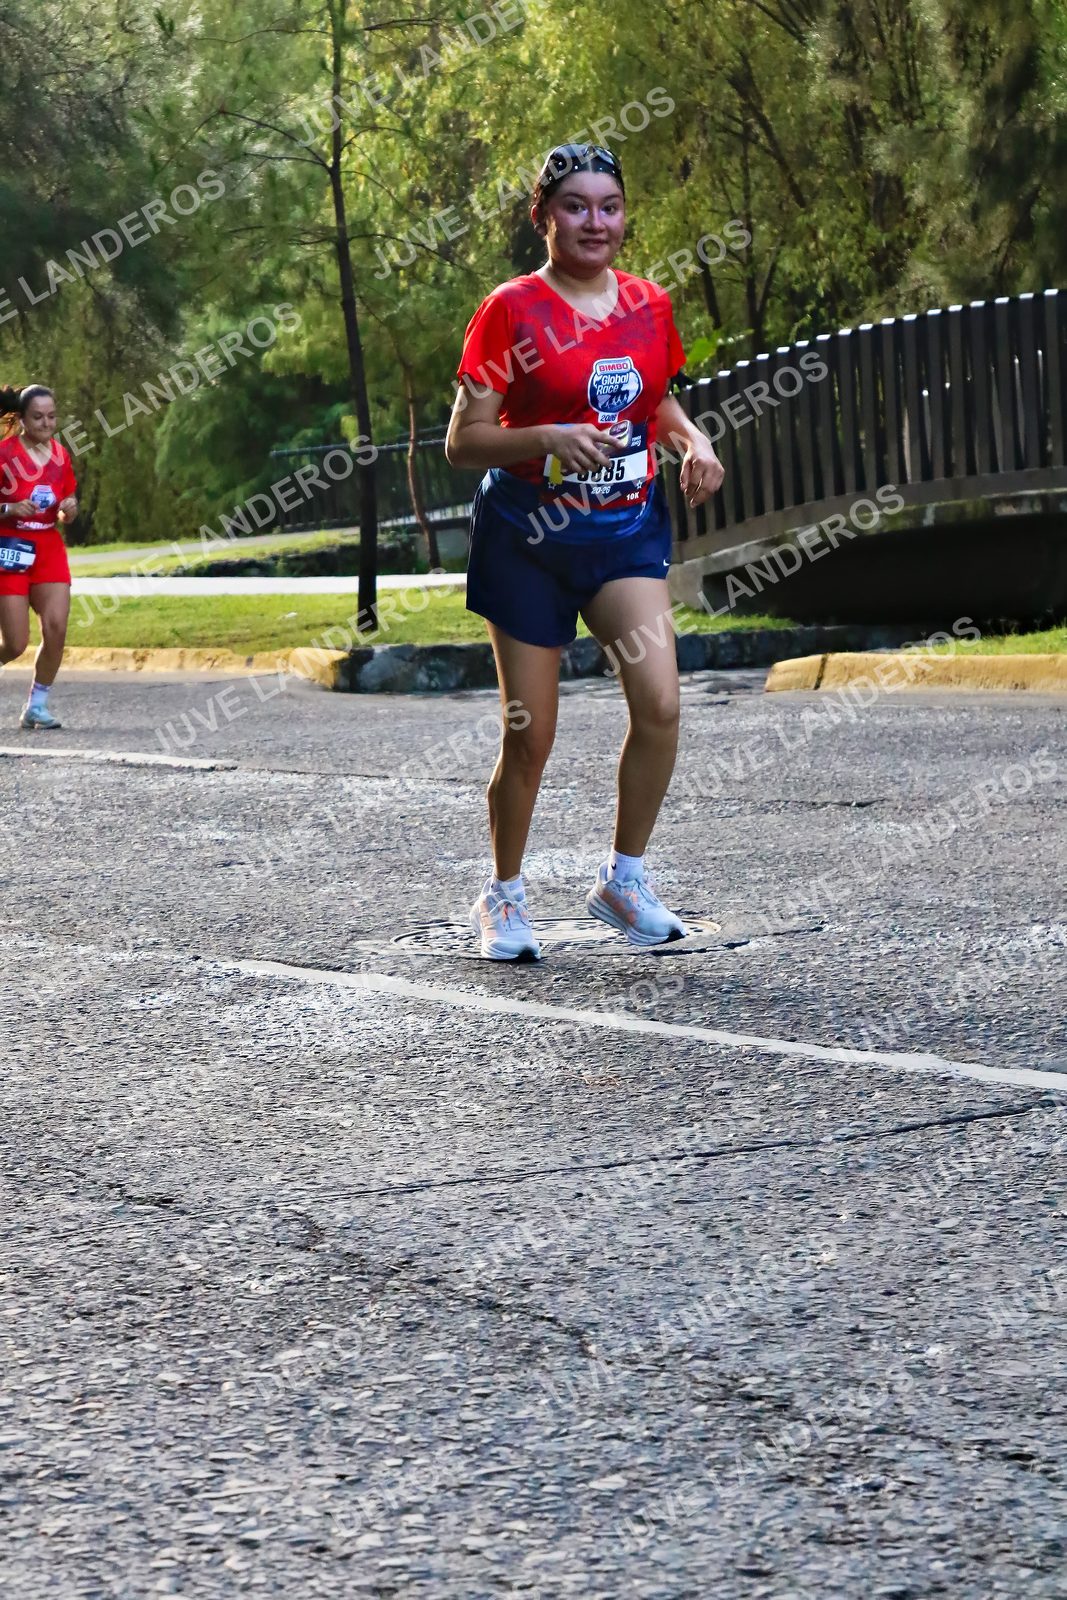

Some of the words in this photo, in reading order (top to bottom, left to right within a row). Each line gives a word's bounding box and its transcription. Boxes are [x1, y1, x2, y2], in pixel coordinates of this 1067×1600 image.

[599, 362, 628, 372] BIMBO
[601, 373, 629, 386] Global
[597, 384, 619, 395] Race
[626, 492, 640, 501] 10K
[0, 548, 21, 562] 5136
